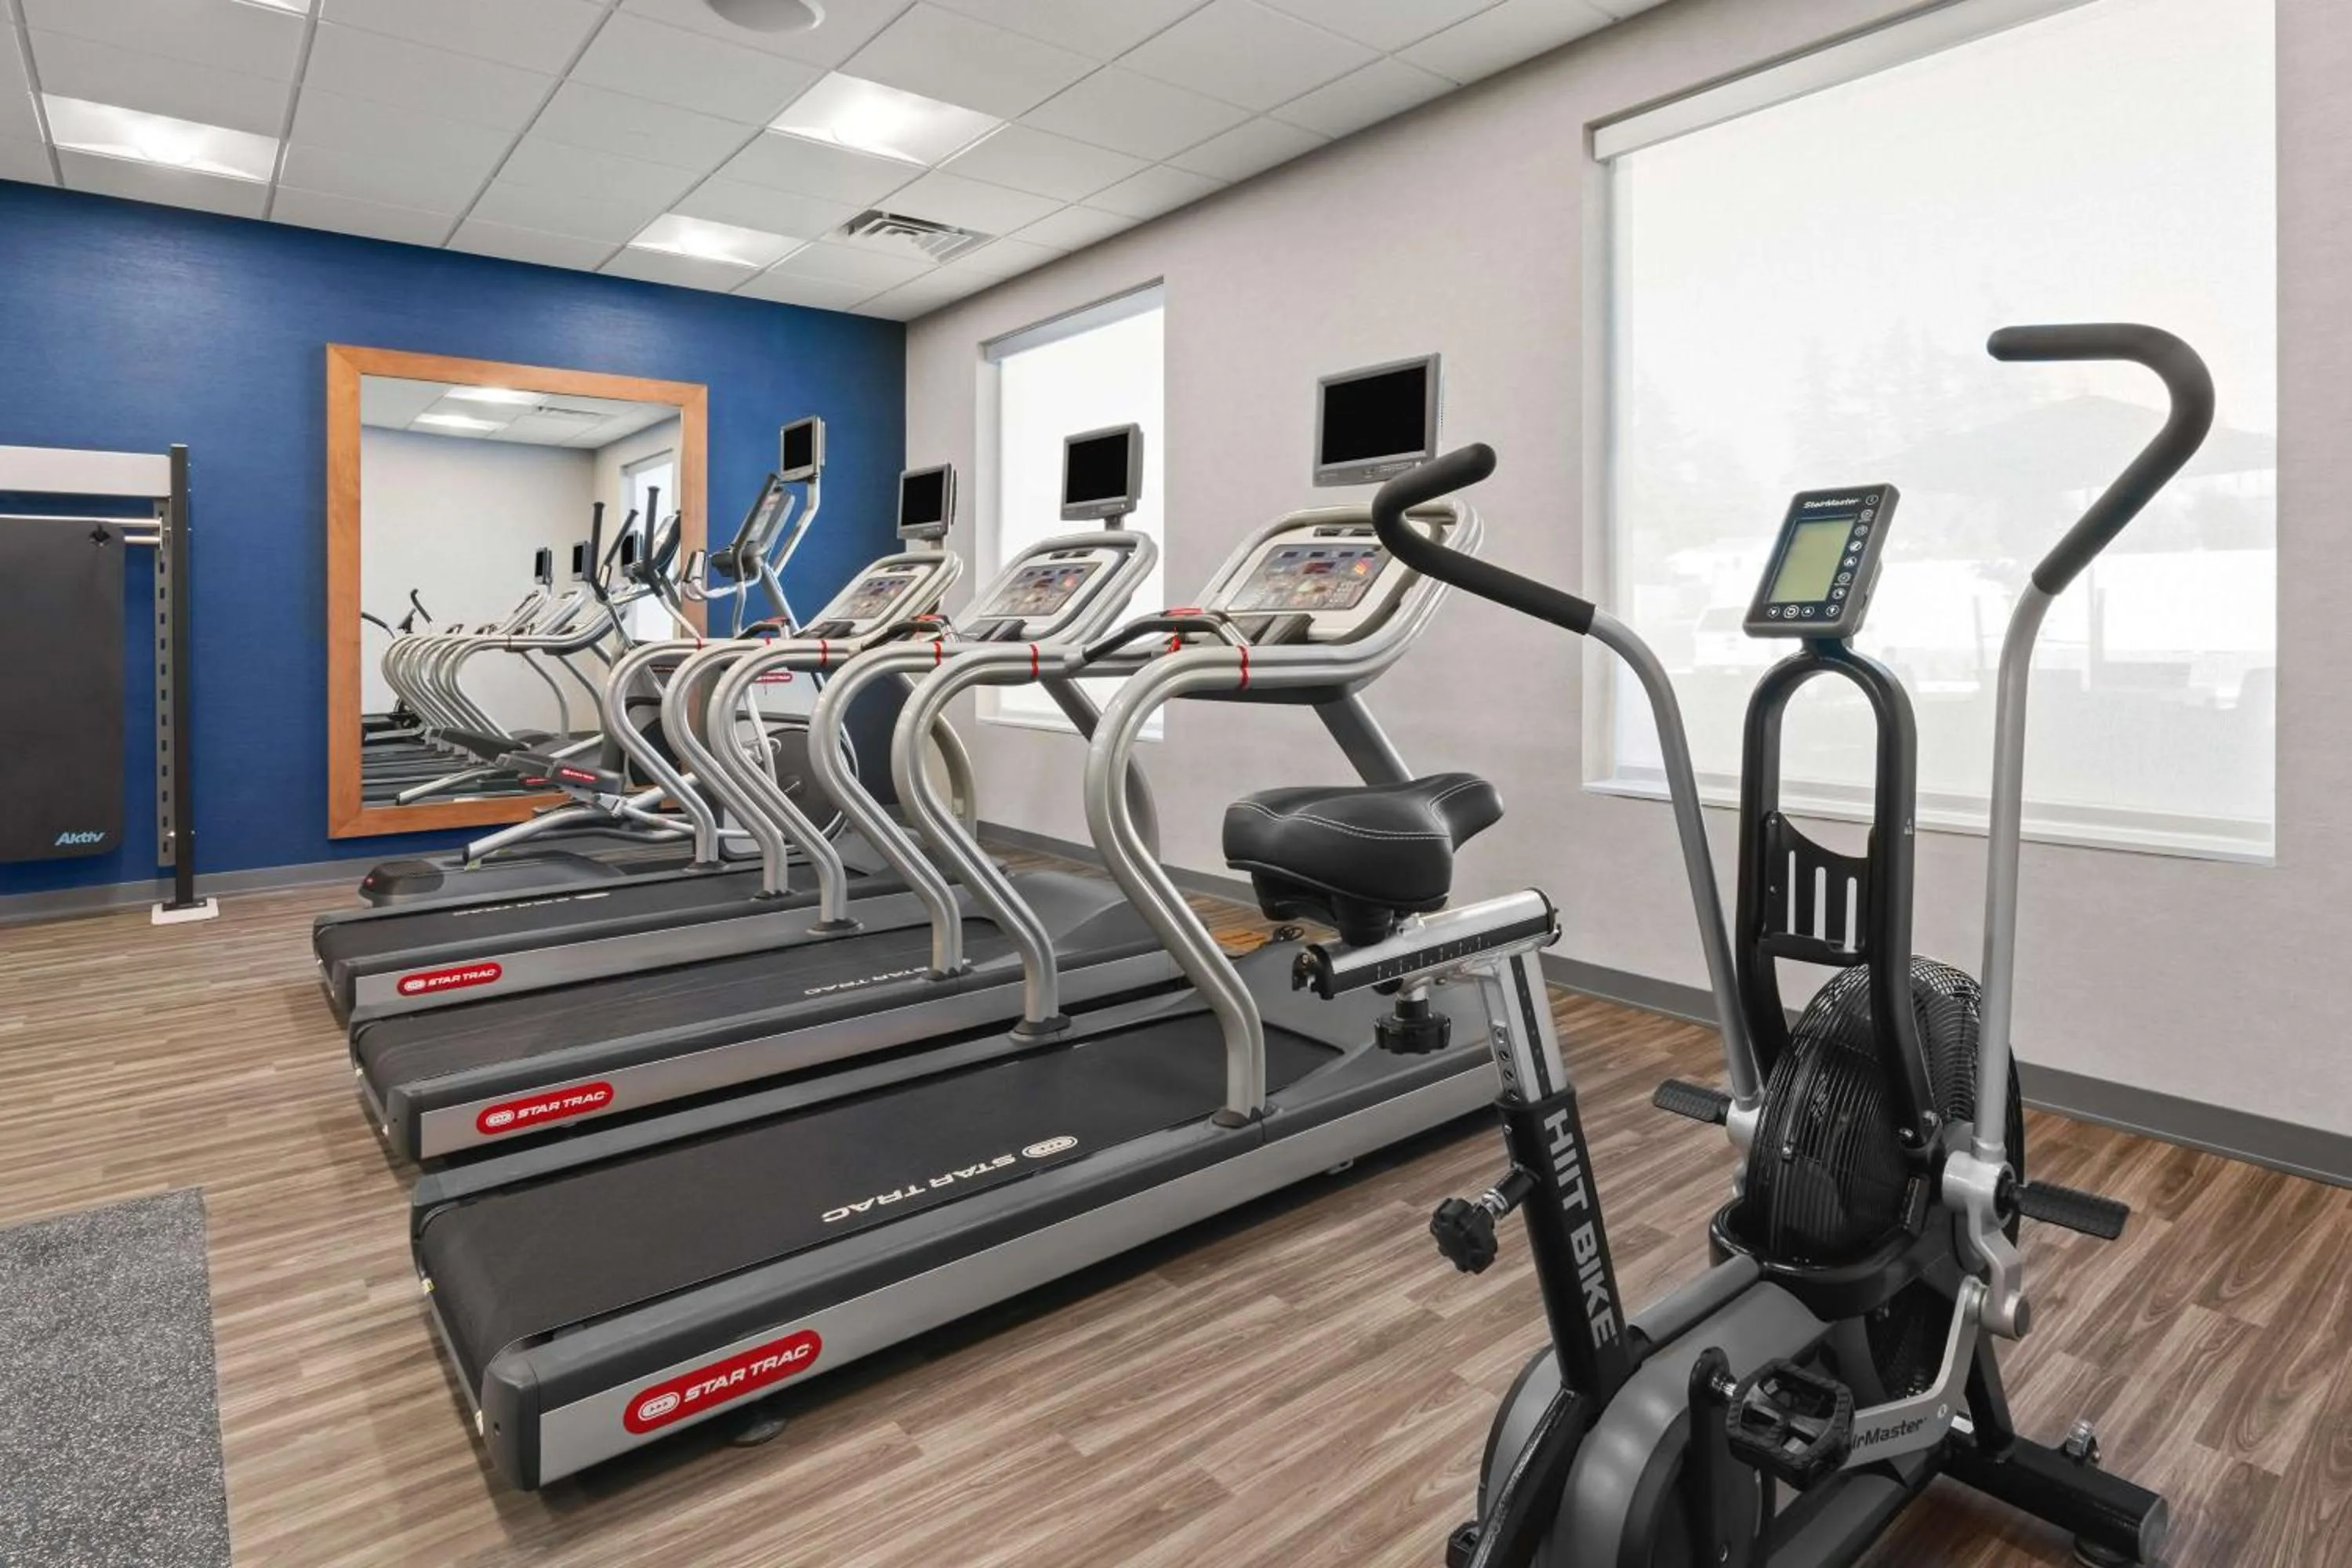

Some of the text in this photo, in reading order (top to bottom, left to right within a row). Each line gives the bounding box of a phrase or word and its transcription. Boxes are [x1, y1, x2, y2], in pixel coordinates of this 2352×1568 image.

[463, 968, 496, 979] TRAC
[517, 1091, 606, 1119] STAR TRAC
[821, 1154, 1017, 1223] STAR TRAC
[1544, 1109, 1617, 1348] HIIT BIKE
[684, 1343, 810, 1403] STAR TRAC
[1852, 1417, 1924, 1450] irMaster
